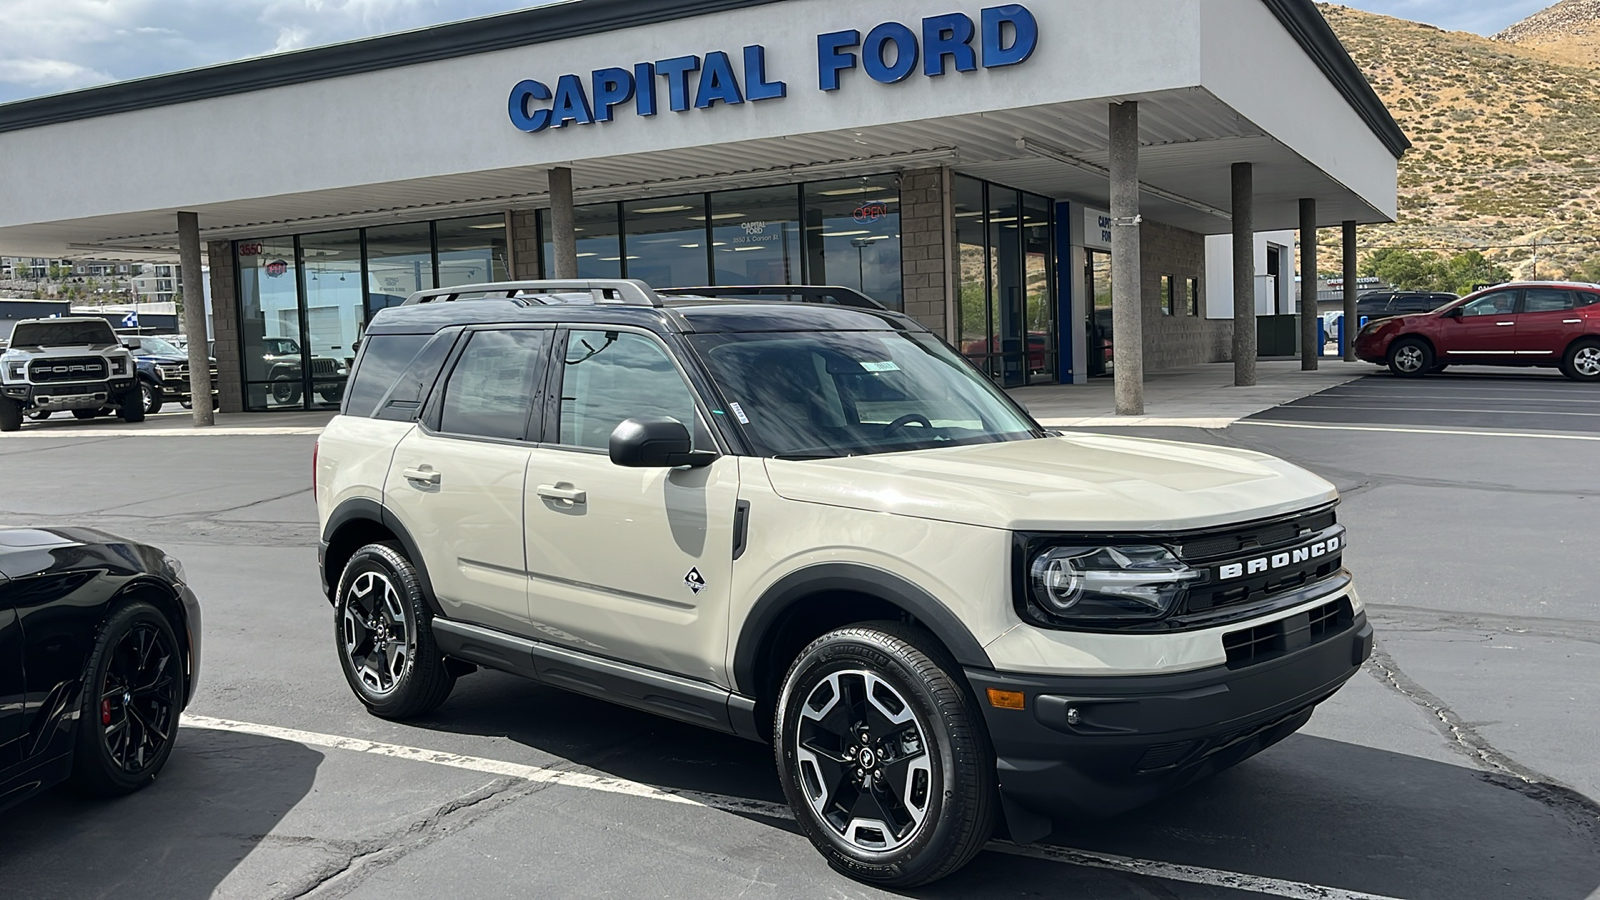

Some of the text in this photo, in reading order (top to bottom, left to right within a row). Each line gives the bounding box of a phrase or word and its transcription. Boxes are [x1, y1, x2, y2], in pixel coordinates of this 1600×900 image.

[508, 3, 1039, 133] CAPITAL FORD
[853, 205, 887, 220] OPEN
[741, 221, 766, 229] CAPITAL
[746, 227, 763, 235] FORD
[239, 243, 263, 256] 3550
[32, 364, 102, 374] FORD
[1219, 536, 1339, 580] BRONCO
[835, 645, 887, 665] MICHELIN
